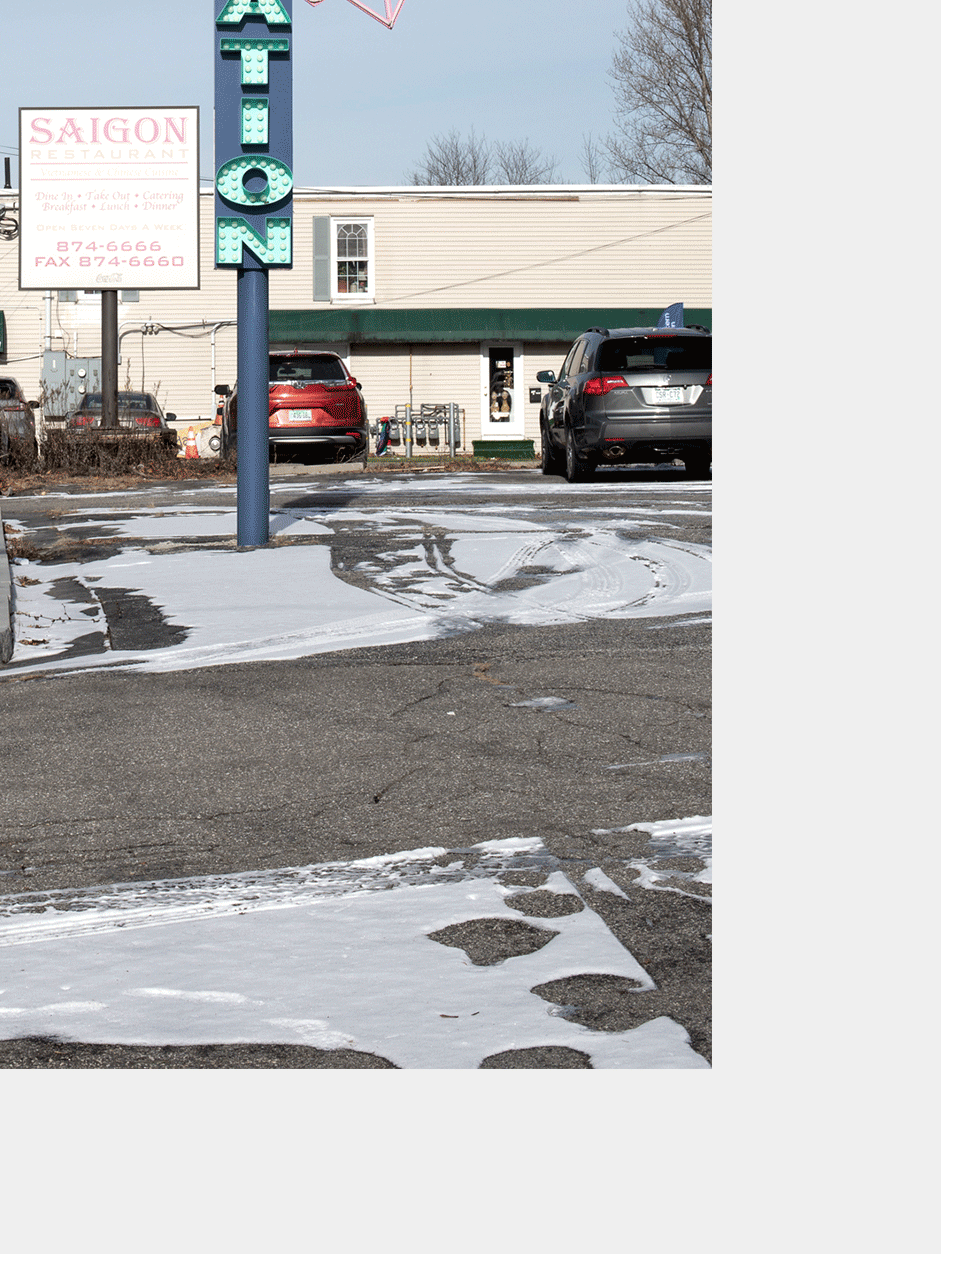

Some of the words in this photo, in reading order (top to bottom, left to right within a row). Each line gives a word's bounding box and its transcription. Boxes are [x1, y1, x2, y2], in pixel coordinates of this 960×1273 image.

[29, 116, 190, 145] SAIGON
[30, 149, 189, 159] RESTAURANT
[40, 167, 92, 177] Vietnamese
[94, 168, 105, 176] &
[107, 166, 142, 177] Chinese
[144, 167, 179, 177] Cuisine
[34, 191, 59, 201] Dine
[60, 191, 74, 201] In
[85, 189, 110, 201] Take
[112, 191, 130, 201] Out
[142, 190, 184, 204] Catering
[42, 200, 88, 216] Breakfast
[99, 201, 130, 211] Lunch
[142, 201, 178, 211] Dinner
[56, 241, 162, 252] 874-6666
[34, 256, 71, 268] FAX
[78, 256, 184, 268] 874-6660
